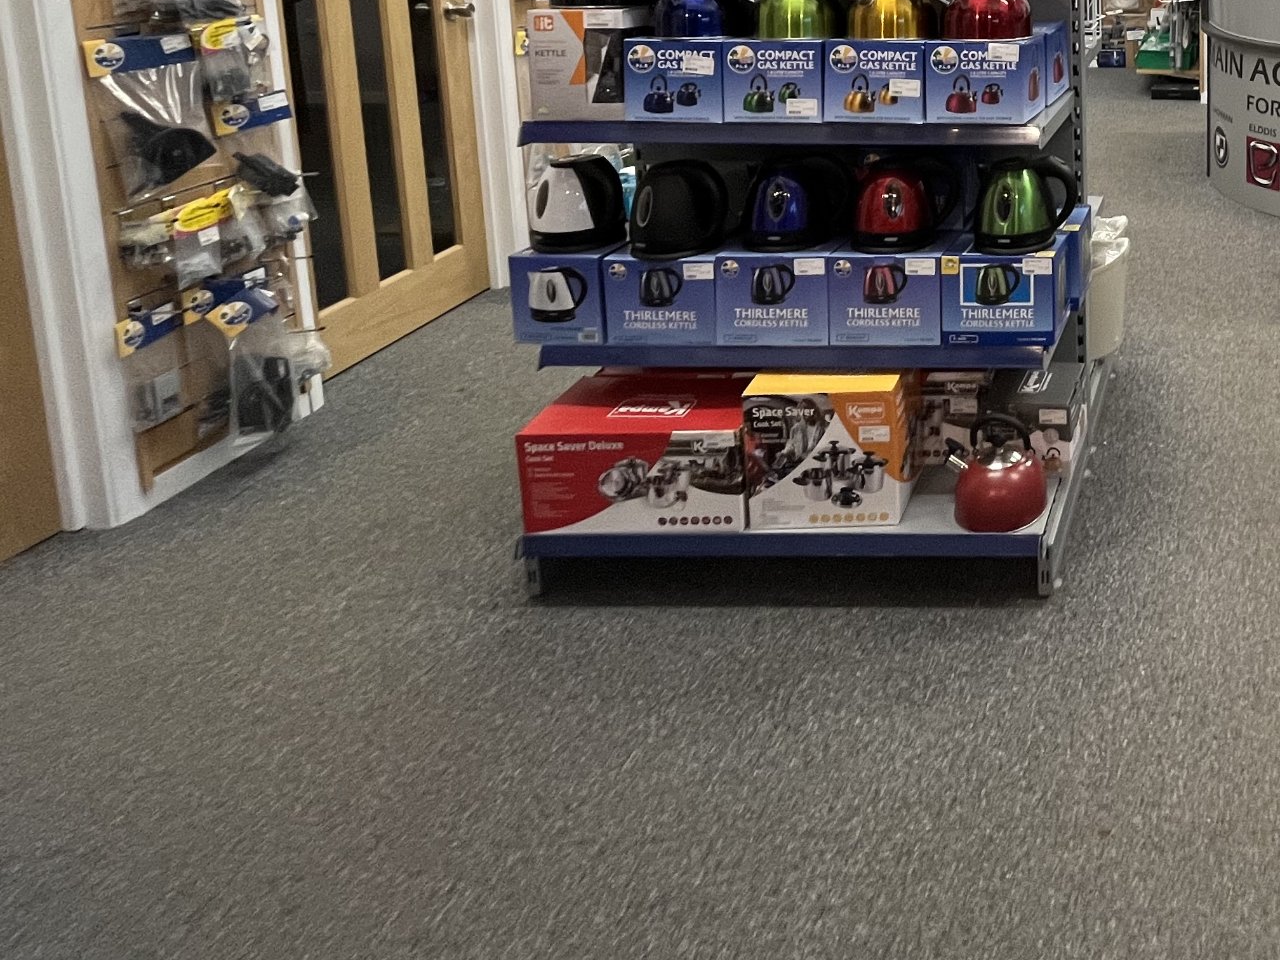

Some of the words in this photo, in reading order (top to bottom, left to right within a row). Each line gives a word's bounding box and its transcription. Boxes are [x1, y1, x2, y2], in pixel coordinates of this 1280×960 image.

[535, 49, 566, 57] KETTLE
[757, 50, 815, 61] COMPACT
[859, 50, 917, 61] COMPACT
[658, 60, 678, 69] GAS
[757, 61, 777, 70] GAS
[780, 61, 814, 70] KETTLE
[859, 61, 879, 70] GAS
[882, 62, 916, 71] KETTLE
[960, 61, 981, 70] GAS
[983, 61, 1017, 70] KETTLE
[1213, 45, 1243, 79] AIN
[1249, 123, 1277, 137] ELDDIS
[623, 310, 697, 321] THIRLEMERE
[734, 308, 808, 319] THIRLEMERE
[847, 308, 920, 319] THIRLEMERE
[961, 308, 1034, 319] THIRLEMERE
[623, 322, 667, 330] CORDLESS
[668, 322, 697, 330] KETTLE
[734, 319, 777, 328] CORDLESS
[779, 320, 809, 328] KETTLE
[847, 319, 890, 327] CORDLESS
[891, 319, 921, 327] KETTLE
[960, 320, 1003, 328] CORDLESS
[1005, 320, 1035, 328] KETTLE
[752, 407, 783, 419] Space
[785, 407, 815, 417] Saver
[524, 442, 555, 454] Space
[557, 441, 587, 451] Saver
[588, 441, 624, 451] Deluxe
